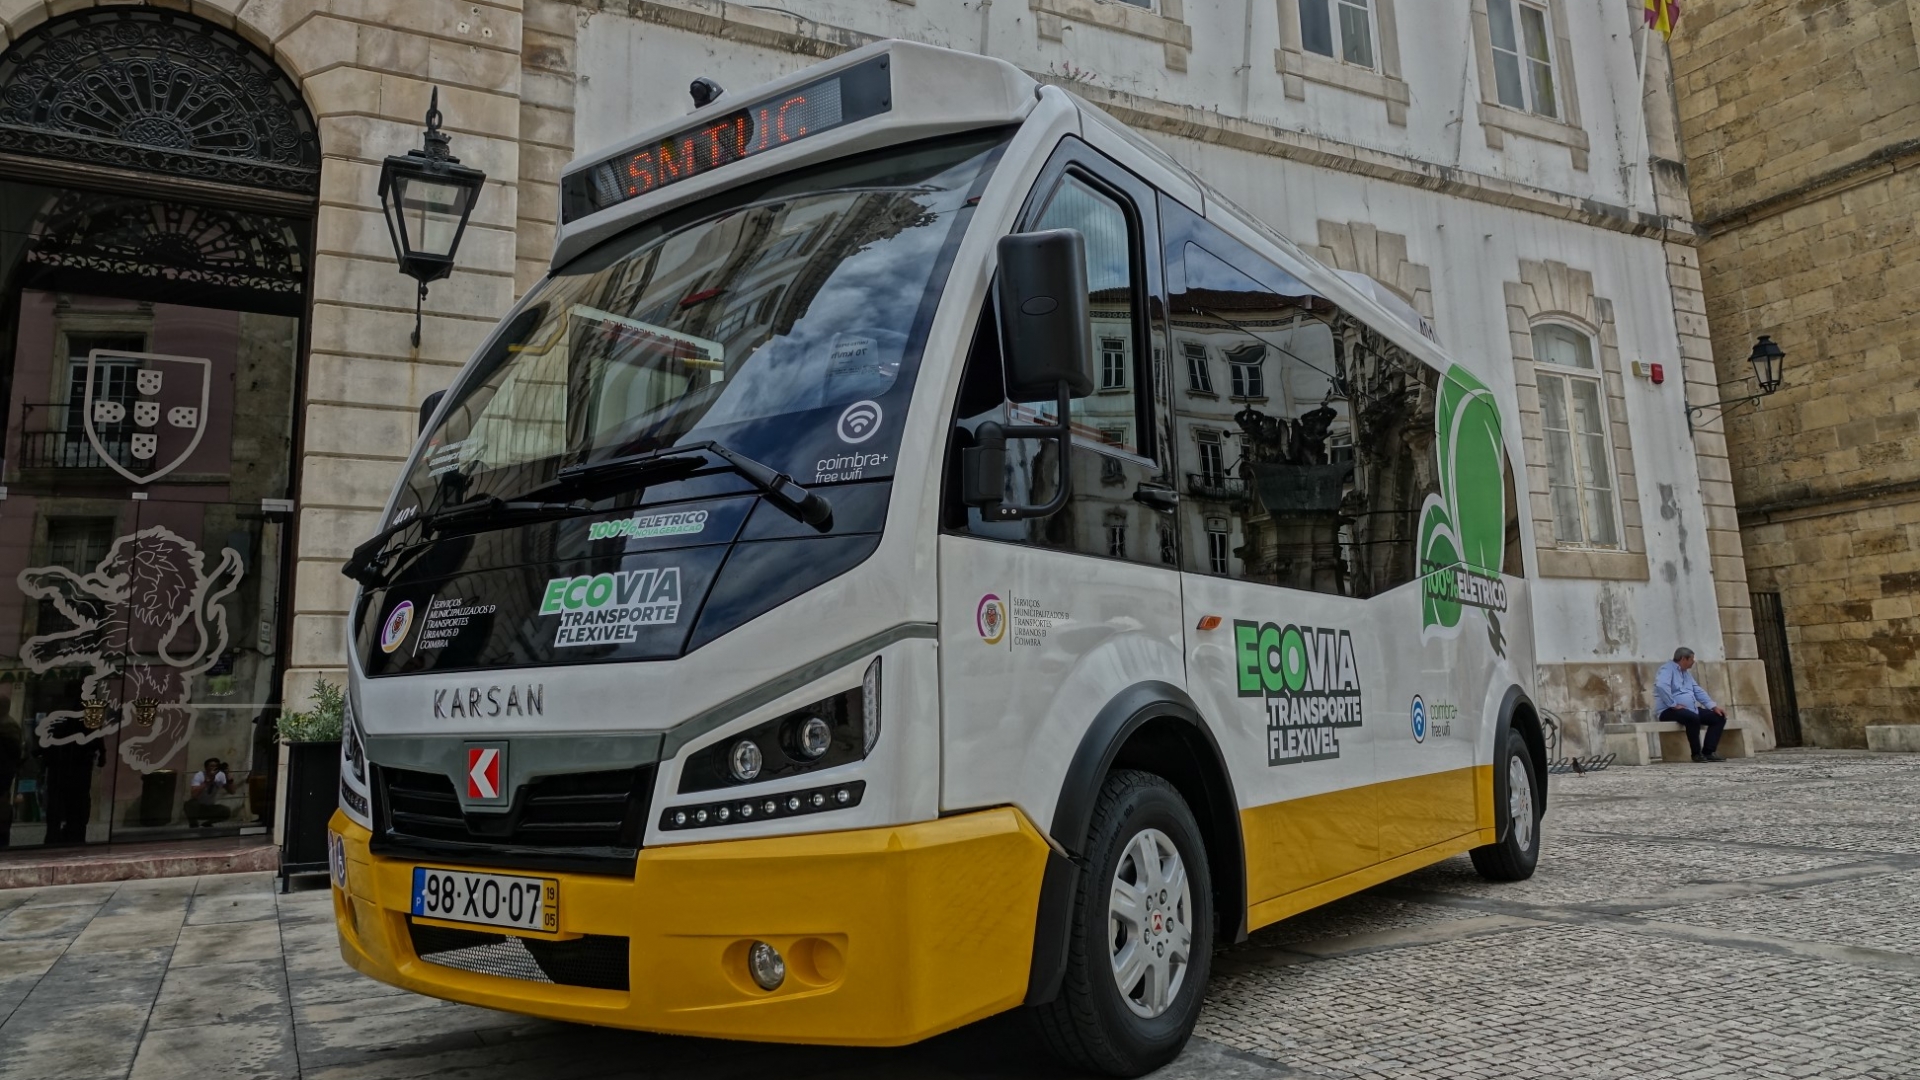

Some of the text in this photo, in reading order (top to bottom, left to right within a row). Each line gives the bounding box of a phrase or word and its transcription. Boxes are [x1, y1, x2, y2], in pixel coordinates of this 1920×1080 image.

[628, 96, 806, 195] SMTUC
[816, 451, 889, 471] coimbra+
[815, 467, 863, 484] free wifi
[590, 519, 637, 539] 100%
[541, 570, 679, 612] ECOVIA
[1422, 564, 1459, 598] 100%
[426, 617, 470, 629] TRANSPORTES
[562, 605, 677, 627] TRANSPORTE
[1235, 624, 1360, 693] ECOVIA
[434, 684, 544, 719] KARSAN
[1267, 696, 1361, 727] TRANSPORTE
[1430, 699, 1458, 720] coimbra+
[1431, 721, 1441, 737] free
[415, 896, 422, 908] P
[546, 886, 555, 901] 19
[544, 913, 556, 927] 05
